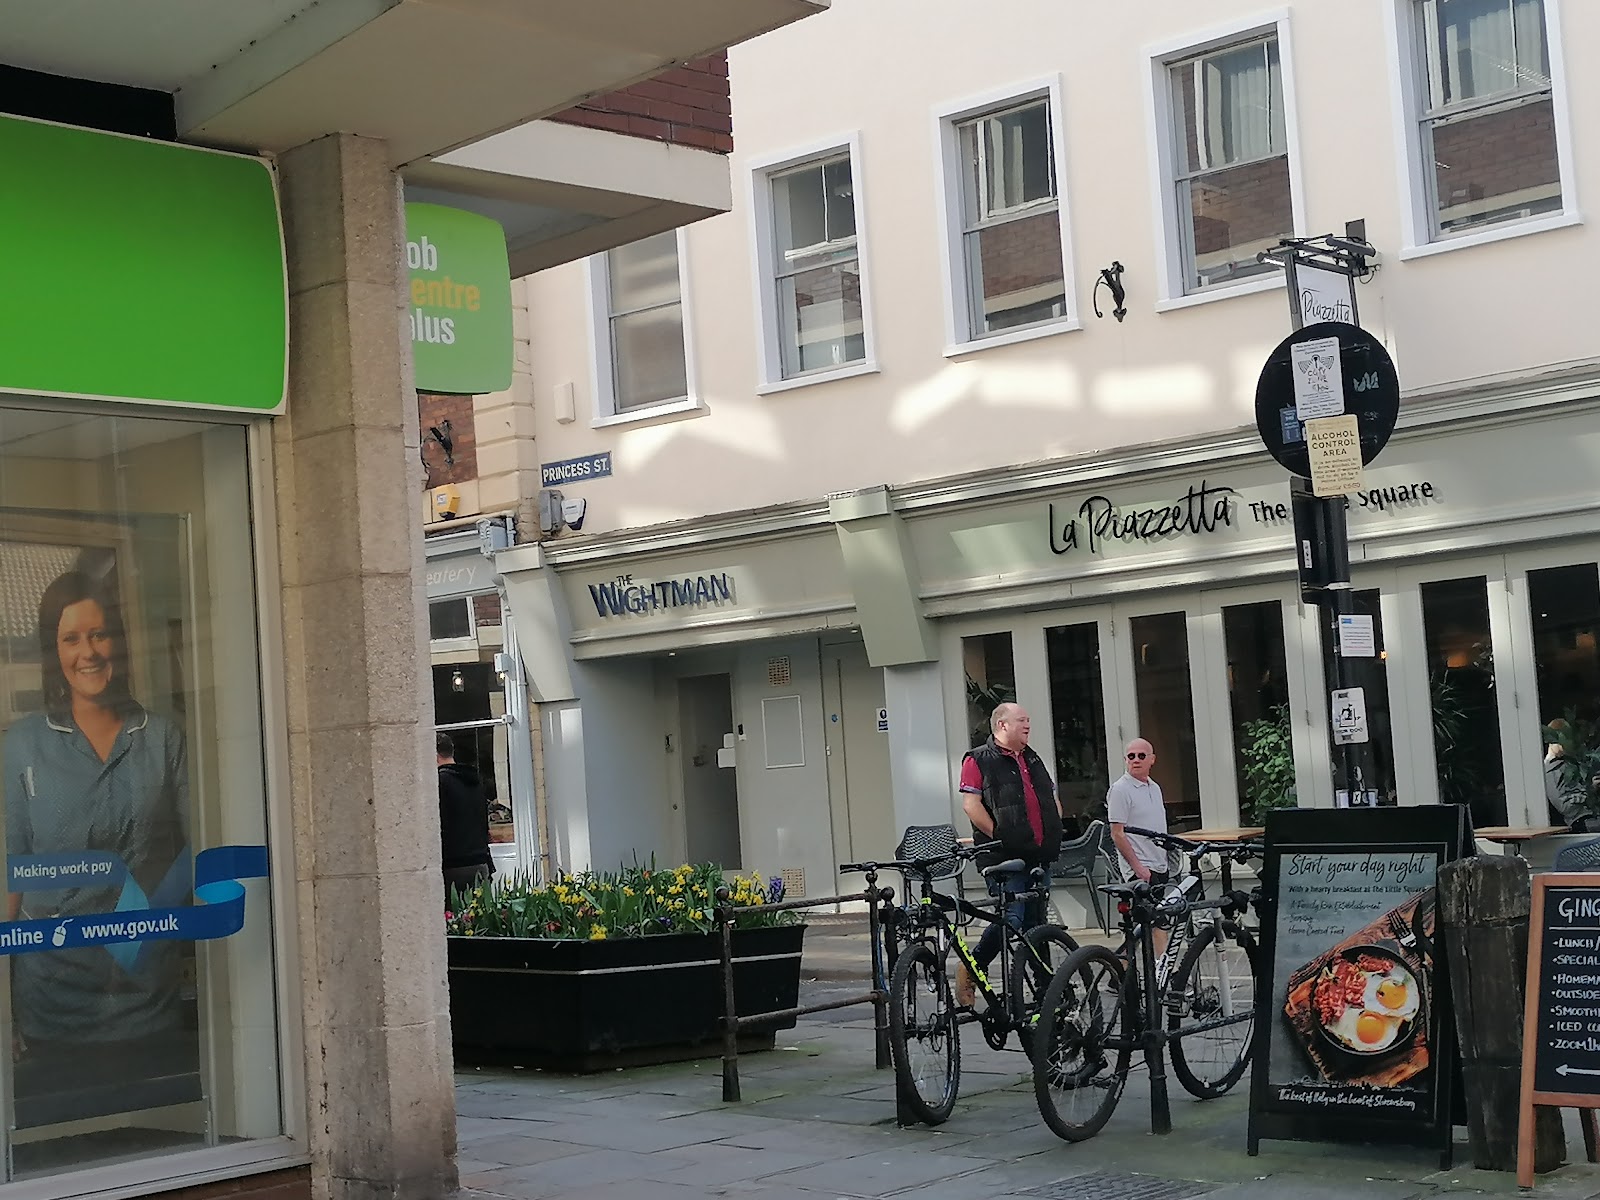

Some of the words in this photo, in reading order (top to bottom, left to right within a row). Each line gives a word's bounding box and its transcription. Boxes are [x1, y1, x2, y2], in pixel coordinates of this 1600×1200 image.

[1311, 430, 1356, 441] ALCOHOL
[1312, 439, 1357, 449] CONTROL
[1323, 448, 1347, 457] AREA
[543, 462, 591, 482] PRINCESS
[594, 457, 611, 475] ST.
[1049, 503, 1078, 554] La
[1079, 479, 1235, 553] Piazzetta
[1249, 500, 1287, 522] The
[426, 566, 477, 586] eatery
[616, 574, 634, 587] THE
[588, 573, 731, 617] WIGHTMAN
[13, 861, 57, 879] Making
[60, 860, 89, 876] work
[91, 860, 113, 876] pay
[1288, 853, 1328, 875] Start
[1326, 860, 1359, 883] your
[1360, 852, 1385, 882] day
[1388, 852, 1430, 883] right
[1289, 885, 1304, 893] With
[1310, 886, 1331, 895] hearty
[82, 913, 179, 939] www.gov.uk
[1556, 1021, 1583, 1032] ICED
